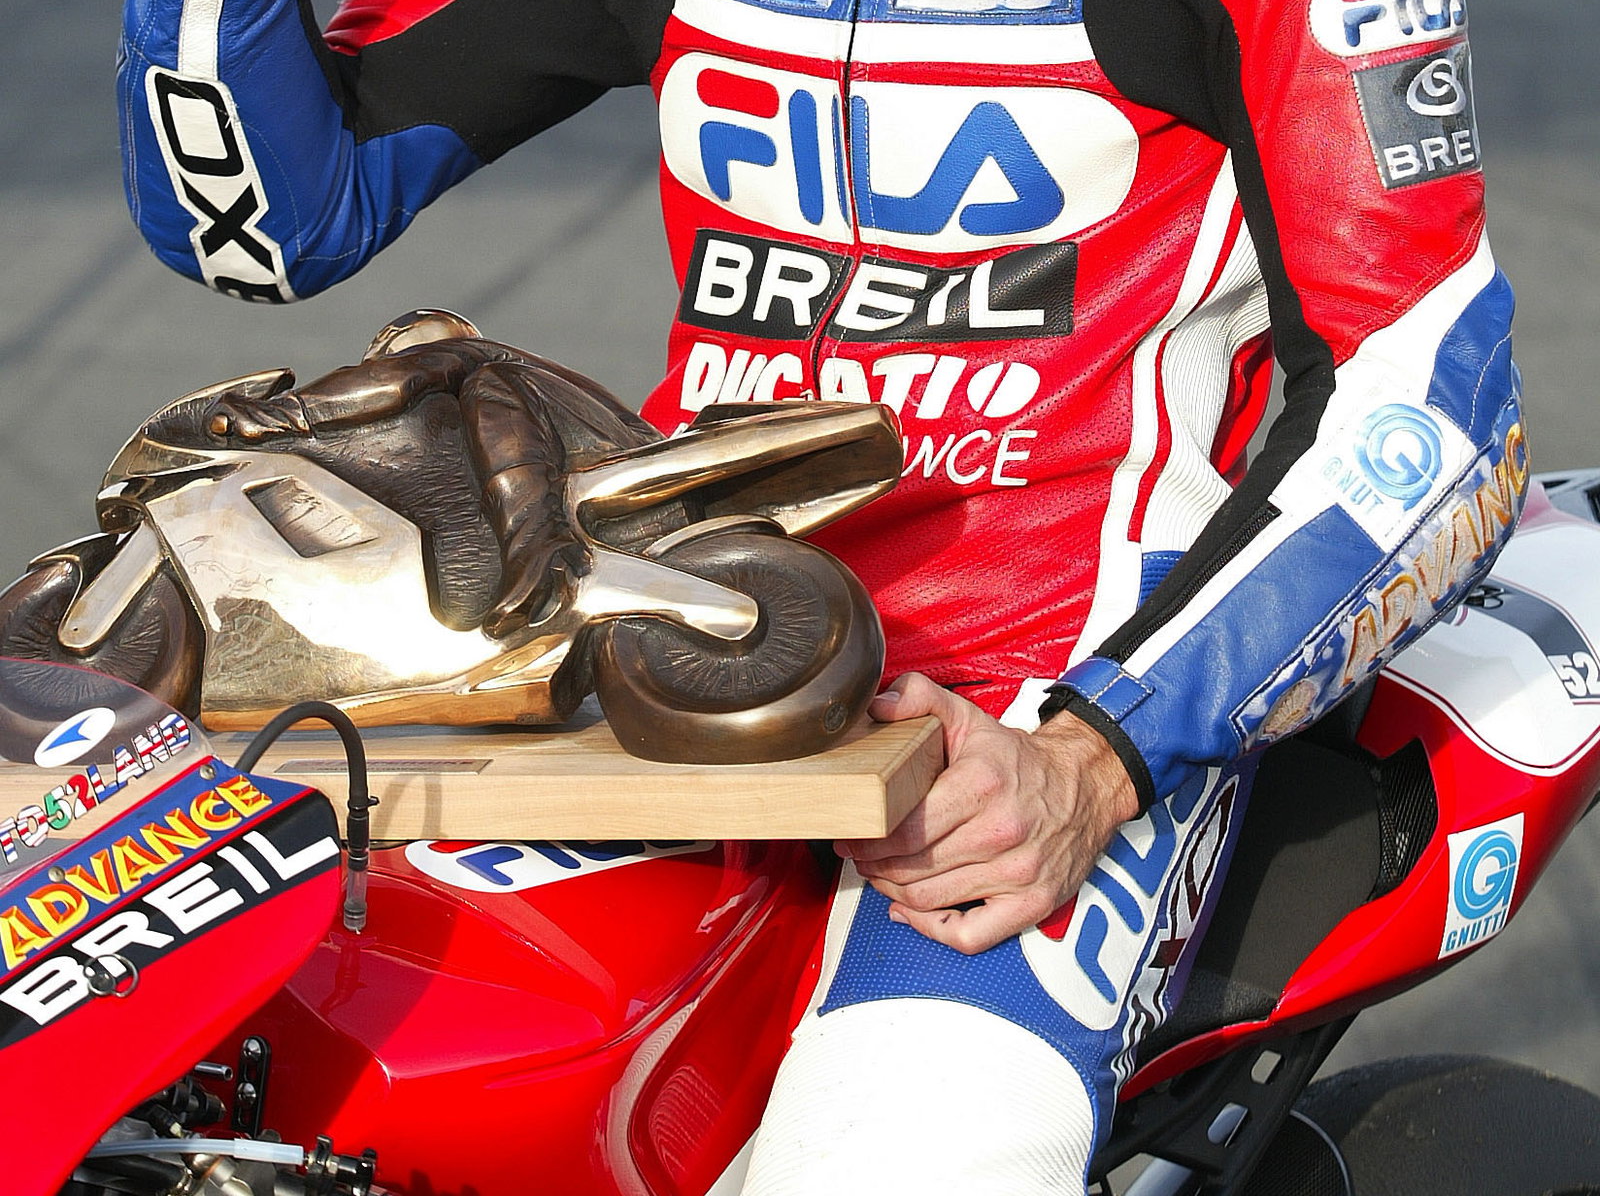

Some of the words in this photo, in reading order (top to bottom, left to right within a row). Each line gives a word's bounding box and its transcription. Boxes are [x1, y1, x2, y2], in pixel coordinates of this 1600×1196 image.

[697, 68, 1064, 236] FILA
[694, 238, 1045, 331] BREIL
[1547, 652, 1600, 697] 52
[0, 774, 273, 971] ADVANCE
[0, 830, 340, 1026] BREIL
[1445, 908, 1506, 952] GNUTTI
